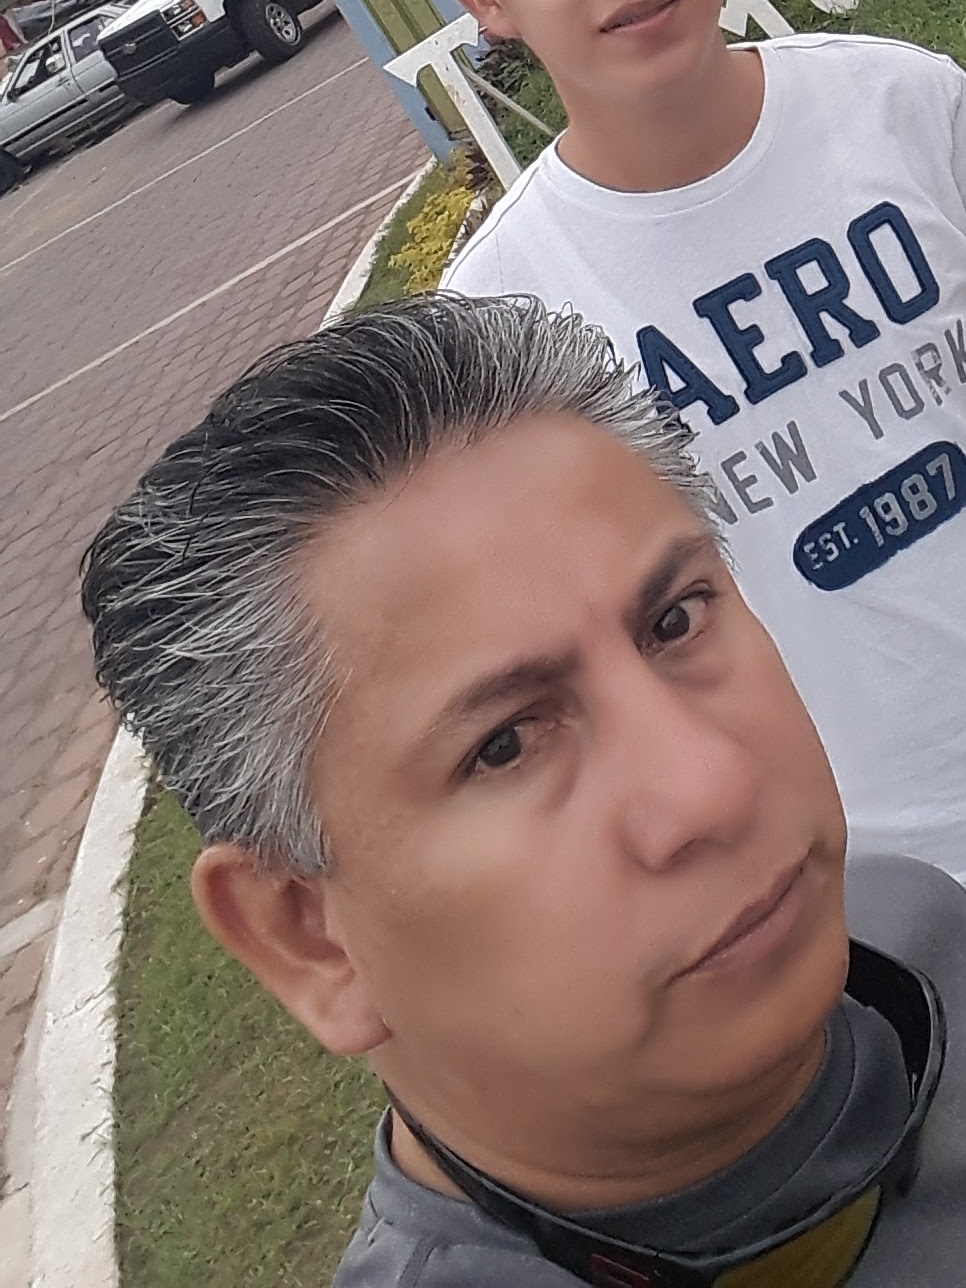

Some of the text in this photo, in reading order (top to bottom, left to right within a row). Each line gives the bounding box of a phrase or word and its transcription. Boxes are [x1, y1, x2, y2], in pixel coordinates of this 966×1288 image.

[635, 200, 941, 426] AERO
[803, 453, 956, 570] EST. 1987
